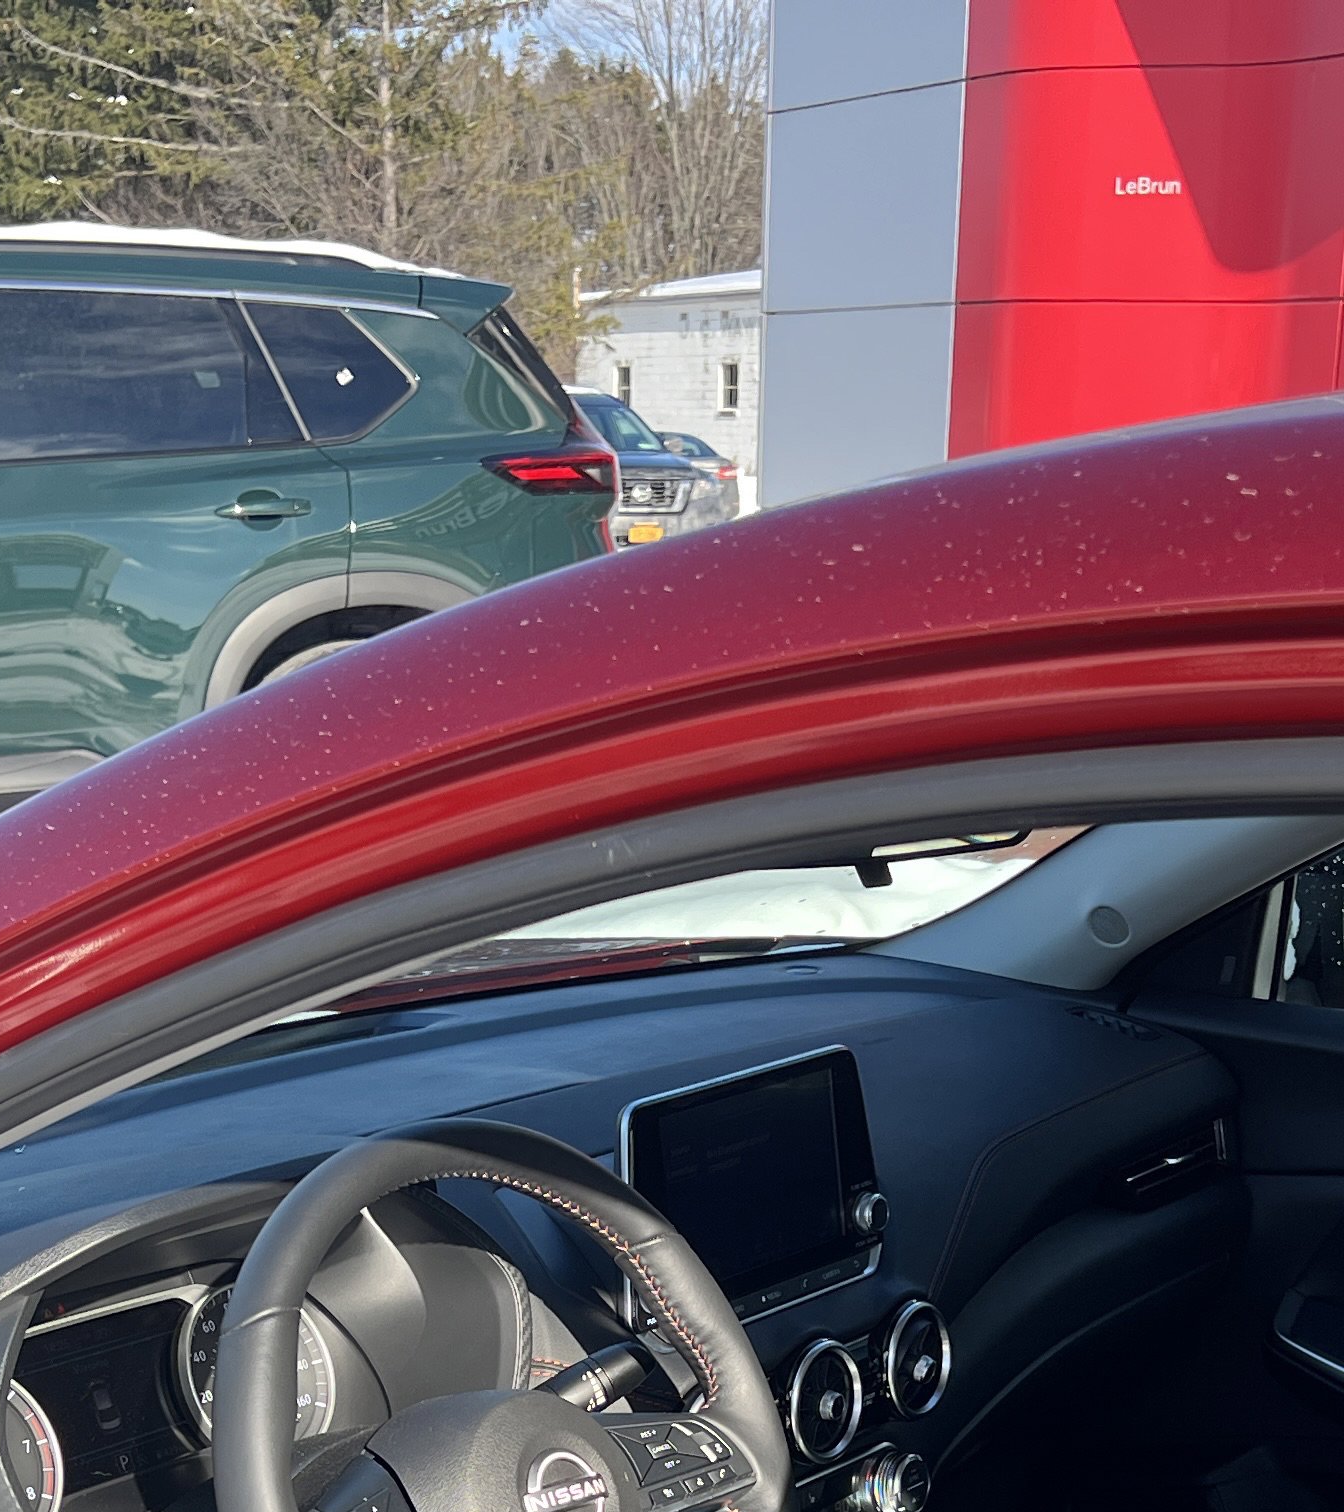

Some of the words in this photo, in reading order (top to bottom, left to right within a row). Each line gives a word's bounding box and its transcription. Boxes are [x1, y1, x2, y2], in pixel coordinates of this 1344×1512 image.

[1115, 176, 1182, 195] LeBrun
[202, 1319, 217, 1334] 60
[193, 1350, 207, 1362] 40
[199, 1389, 214, 1404] 20
[21, 1439, 31, 1454] 7
[119, 1455, 129, 1473] P
[25, 1486, 37, 1501] 8
